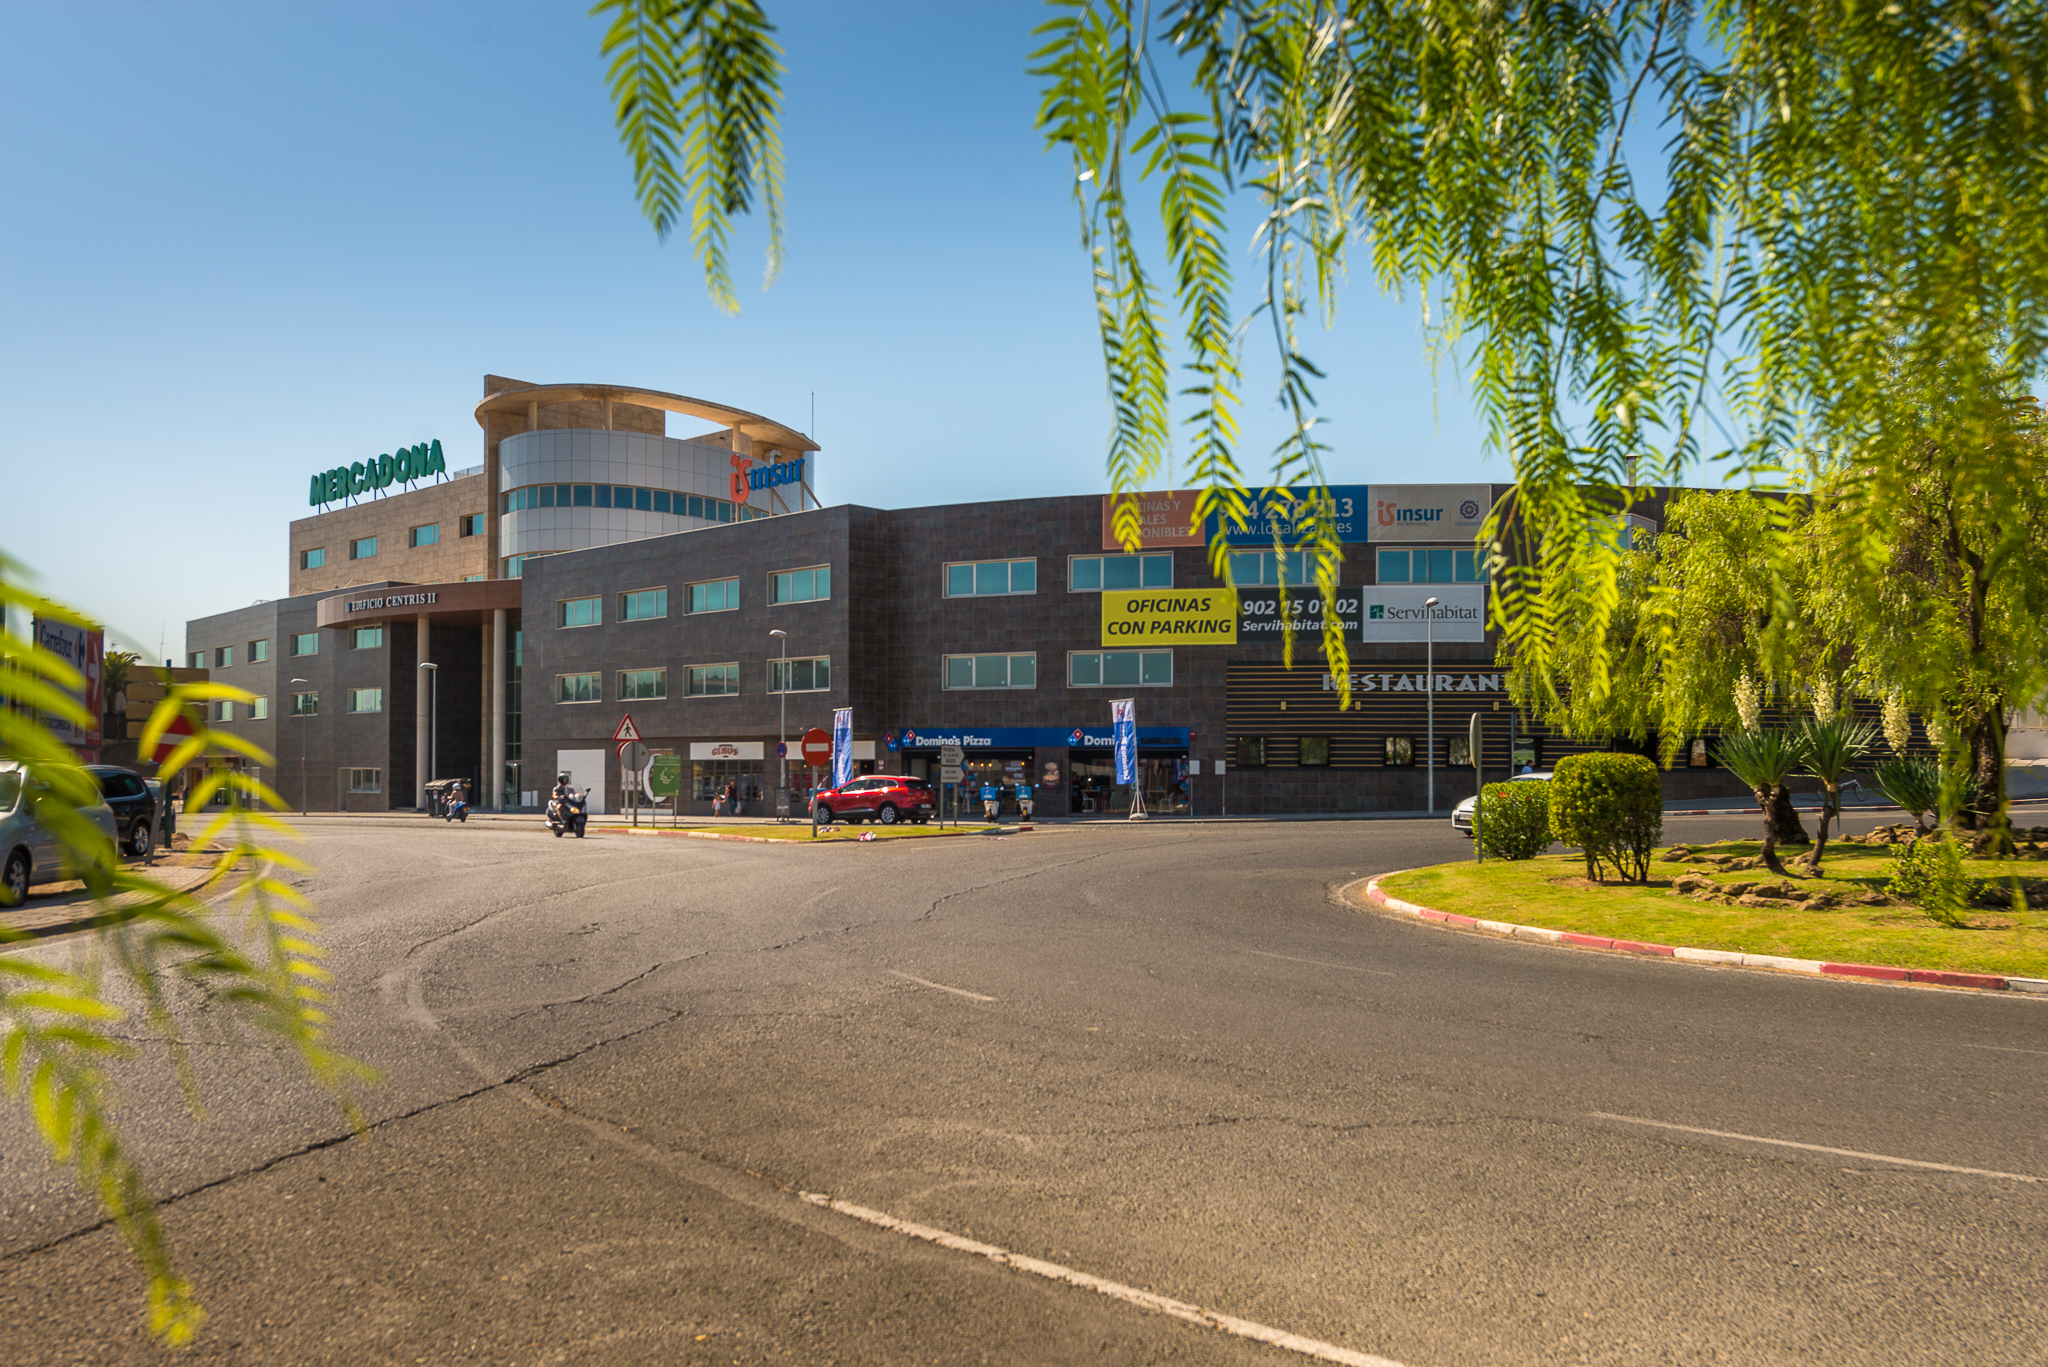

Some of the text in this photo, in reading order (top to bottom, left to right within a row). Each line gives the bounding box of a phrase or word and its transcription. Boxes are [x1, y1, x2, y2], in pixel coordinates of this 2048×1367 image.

[309, 438, 446, 507] MERCADONA
[750, 458, 805, 491] insur
[1173, 500, 1181, 511] Y
[1396, 508, 1444, 521] insur
[352, 592, 437, 612] EDIFICIO CENTRIS II
[1126, 598, 1211, 613] OFICINAS
[1242, 600, 1276, 615] 902
[1335, 598, 1358, 613] 02
[1387, 604, 1479, 620] Servihabitat
[1107, 619, 1232, 635] CON PARKING
[915, 735, 992, 746] Domino's Pizza
